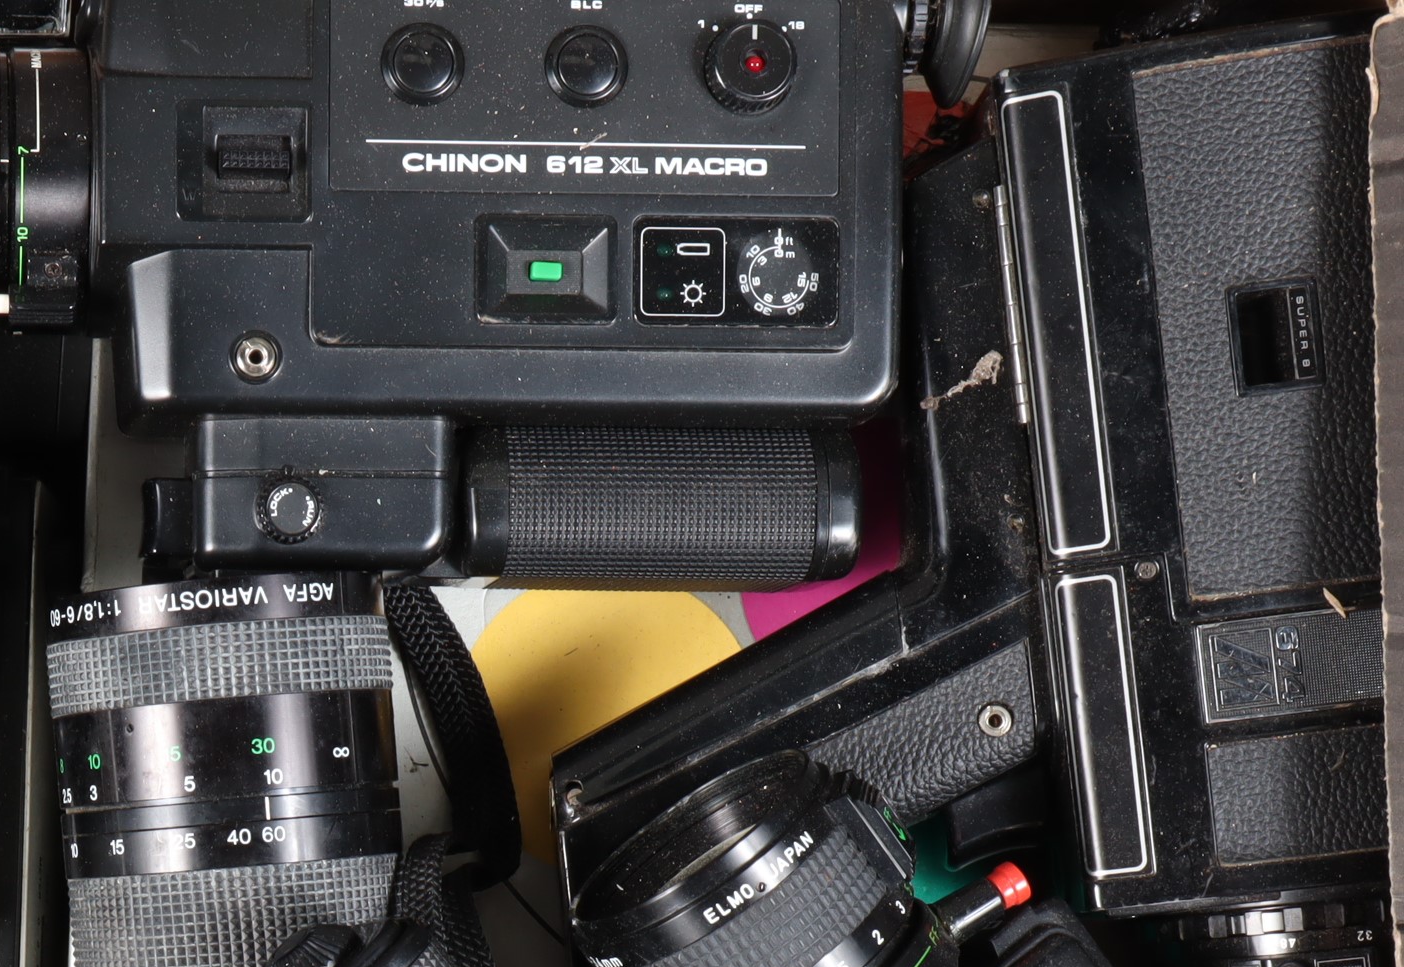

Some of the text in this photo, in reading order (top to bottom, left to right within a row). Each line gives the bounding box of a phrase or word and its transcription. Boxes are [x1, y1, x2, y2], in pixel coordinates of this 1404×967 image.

[734, 3, 763, 13] OFF
[788, 21, 805, 30] 18
[17, 145, 30, 156] 7
[402, 152, 768, 178] CHINON 612 XL MACRO
[16, 226, 29, 243] 10
[739, 244, 819, 316] 10 20 30 40 50
[757, 255, 767, 266] 3
[781, 291, 798, 304] 12
[797, 271, 807, 288] 15
[1295, 295, 1309, 350] SUPER
[269, 487, 290, 517] LOCK
[301, 500, 315, 527] RUN
[139, 586, 269, 616] VARIOSTAR
[282, 582, 334, 603] AGFA
[251, 737, 276, 754] 30
[88, 753, 101, 770] 10
[184, 775, 196, 793] 5
[263, 768, 284, 785] 10
[89, 784, 98, 801] 3
[171, 832, 196, 850] 25
[227, 828, 252, 845] 40
[262, 825, 287, 843] 60
[70, 842, 79, 859] 10
[109, 838, 125, 856] 15
[701, 830, 815, 926] ELMO JAPAN
[895, 900, 906, 915] 3
[871, 928, 885, 946] 2
[1357, 929, 1373, 942] 32
